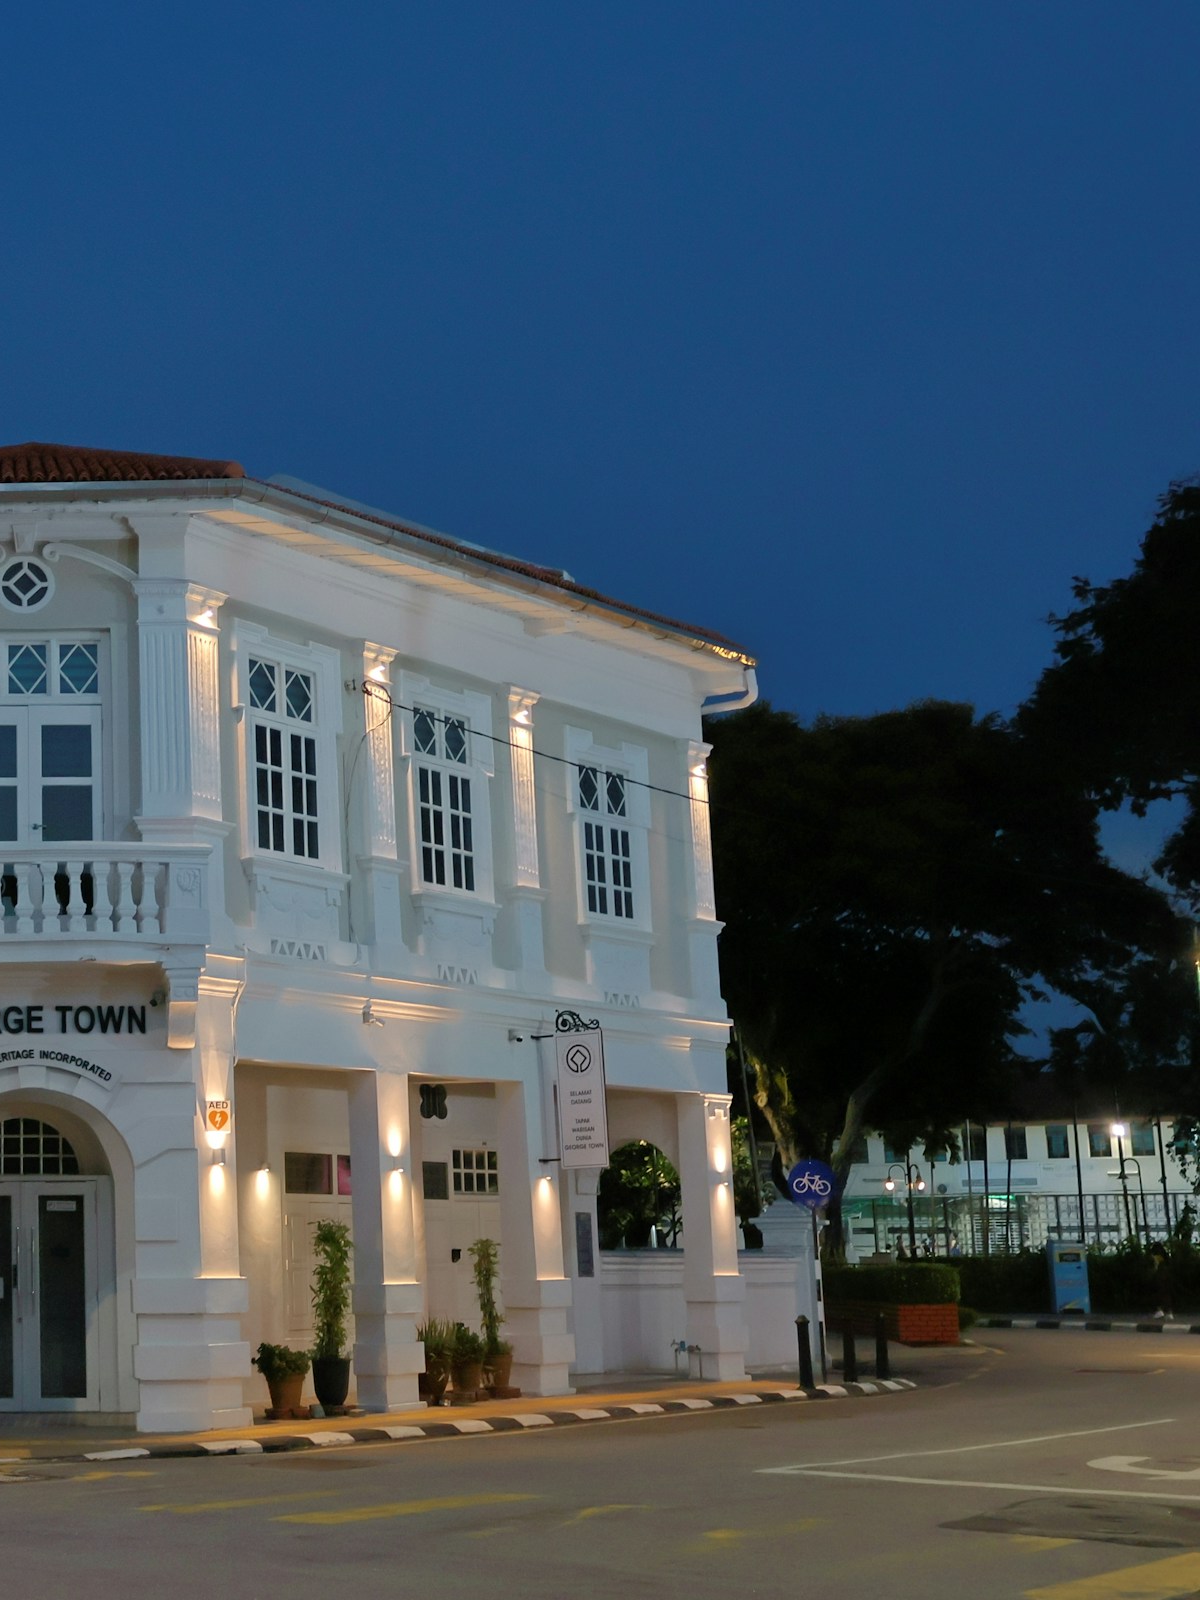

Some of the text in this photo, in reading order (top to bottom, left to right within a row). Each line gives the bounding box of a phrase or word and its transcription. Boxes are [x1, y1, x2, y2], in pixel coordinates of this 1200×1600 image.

[55, 1005, 147, 1034] TOWN
[39, 1050, 112, 1082] INCORPORATED
[209, 1101, 228, 1109] AED
